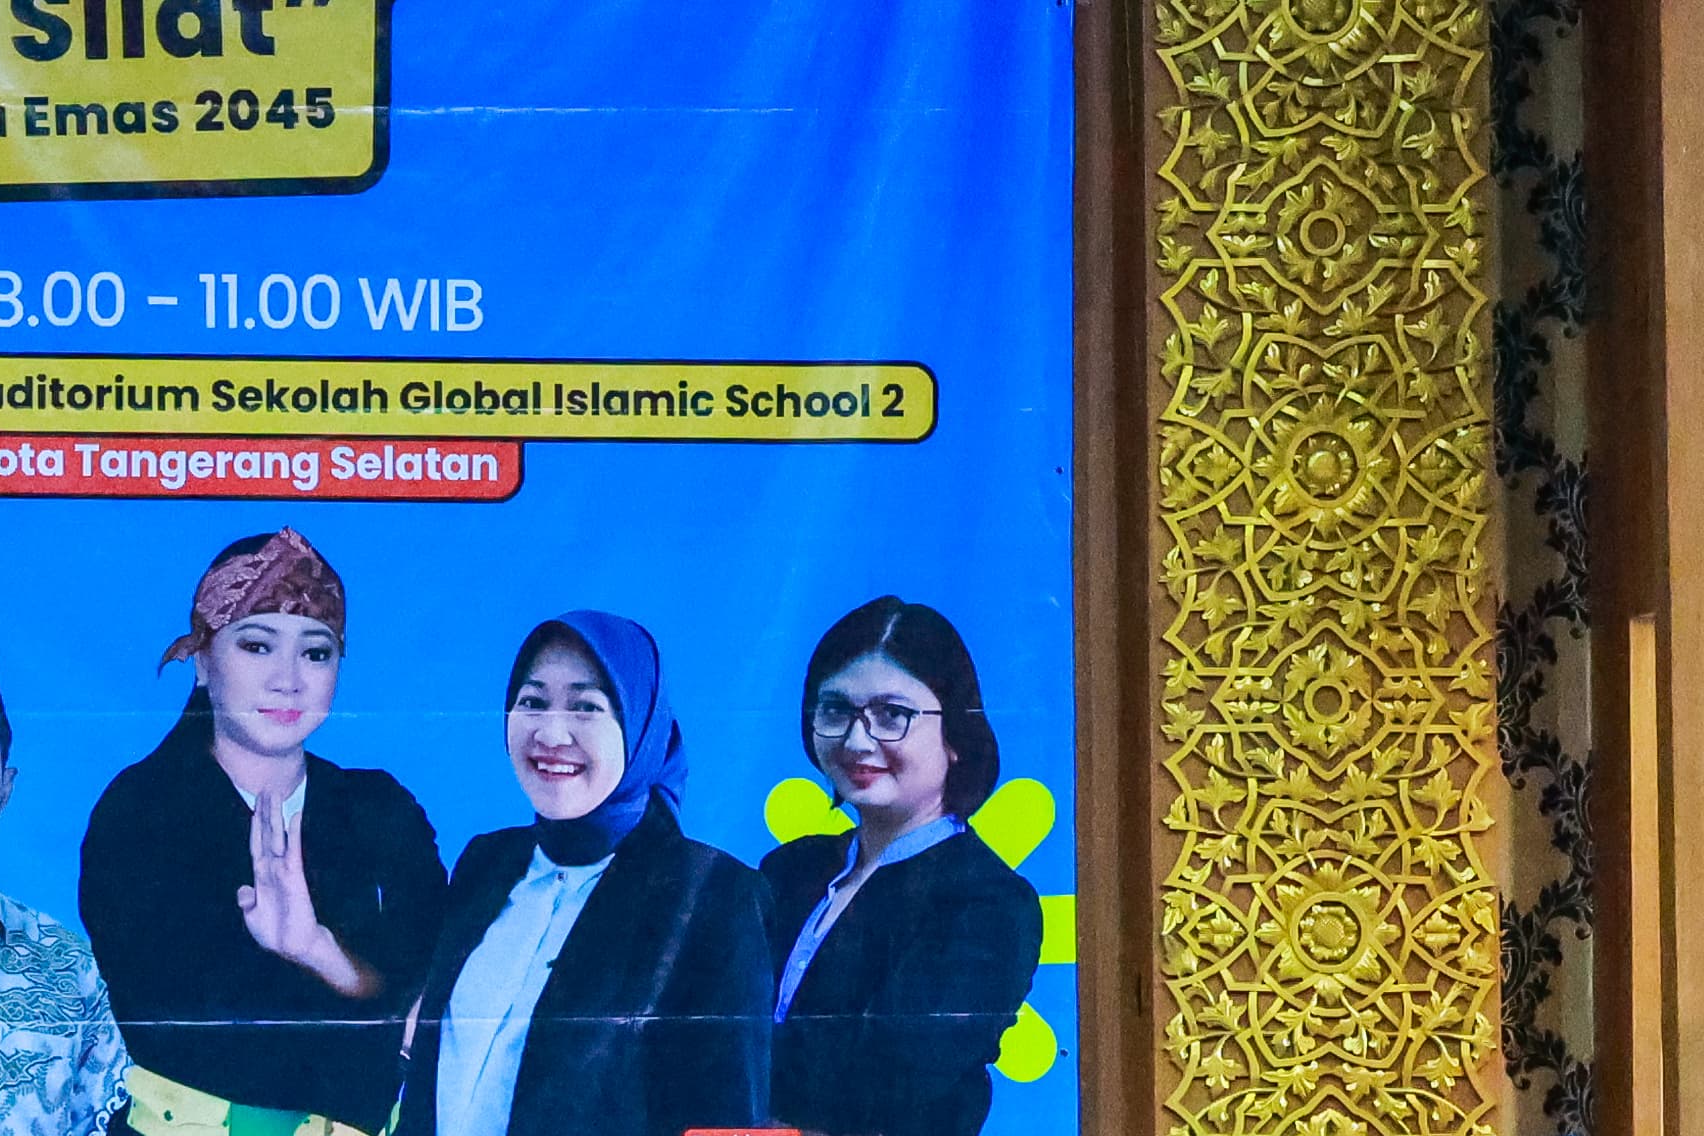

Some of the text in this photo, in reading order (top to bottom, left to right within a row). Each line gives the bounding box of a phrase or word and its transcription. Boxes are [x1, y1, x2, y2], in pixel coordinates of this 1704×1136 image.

[10, 0, 331, 62] Silat
[24, 96, 179, 137] Emas
[195, 88, 335, 132] 2045
[198, 271, 340, 333] 11.00
[358, 276, 484, 333] WIB
[211, 377, 389, 416] Sekolah
[399, 379, 541, 418] Global
[553, 379, 714, 419] Islamic
[724, 381, 870, 420] School
[881, 385, 904, 419] 2
[75, 444, 321, 491] Tangerang
[330, 442, 498, 484] Selatan
